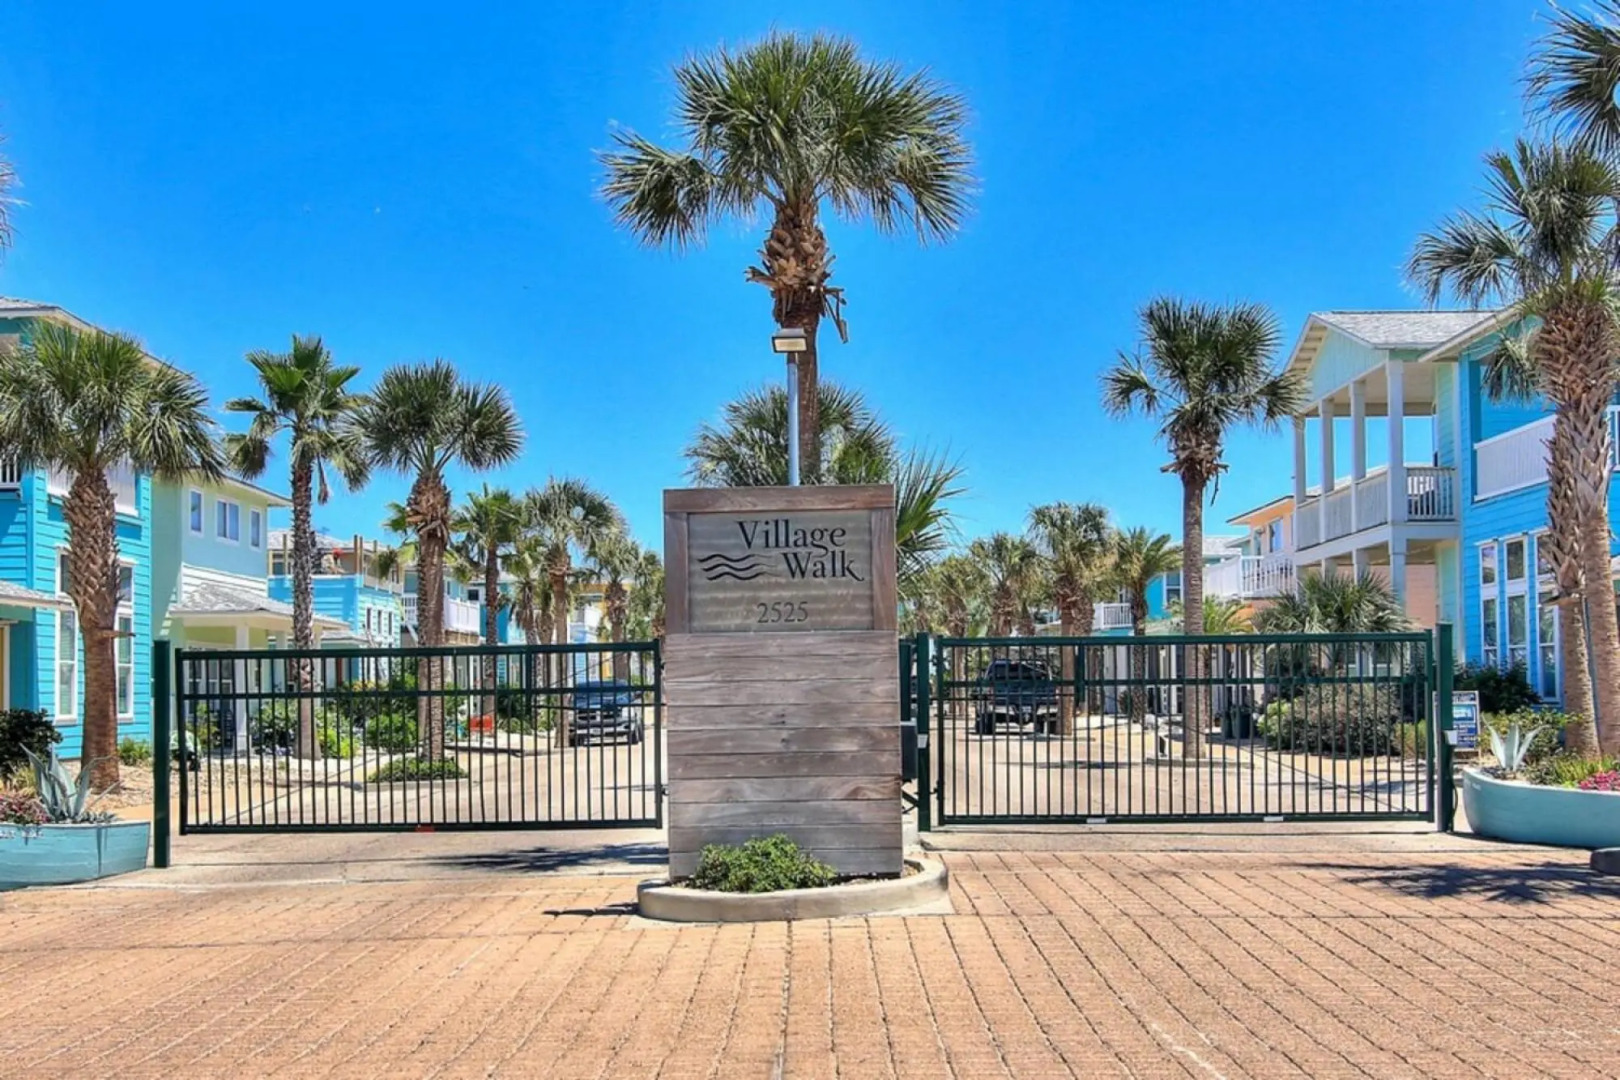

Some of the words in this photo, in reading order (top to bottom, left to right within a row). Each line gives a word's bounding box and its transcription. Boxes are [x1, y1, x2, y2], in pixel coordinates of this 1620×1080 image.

[736, 519, 846, 557] Village
[781, 549, 865, 582] Walk
[757, 601, 809, 624] 2525
